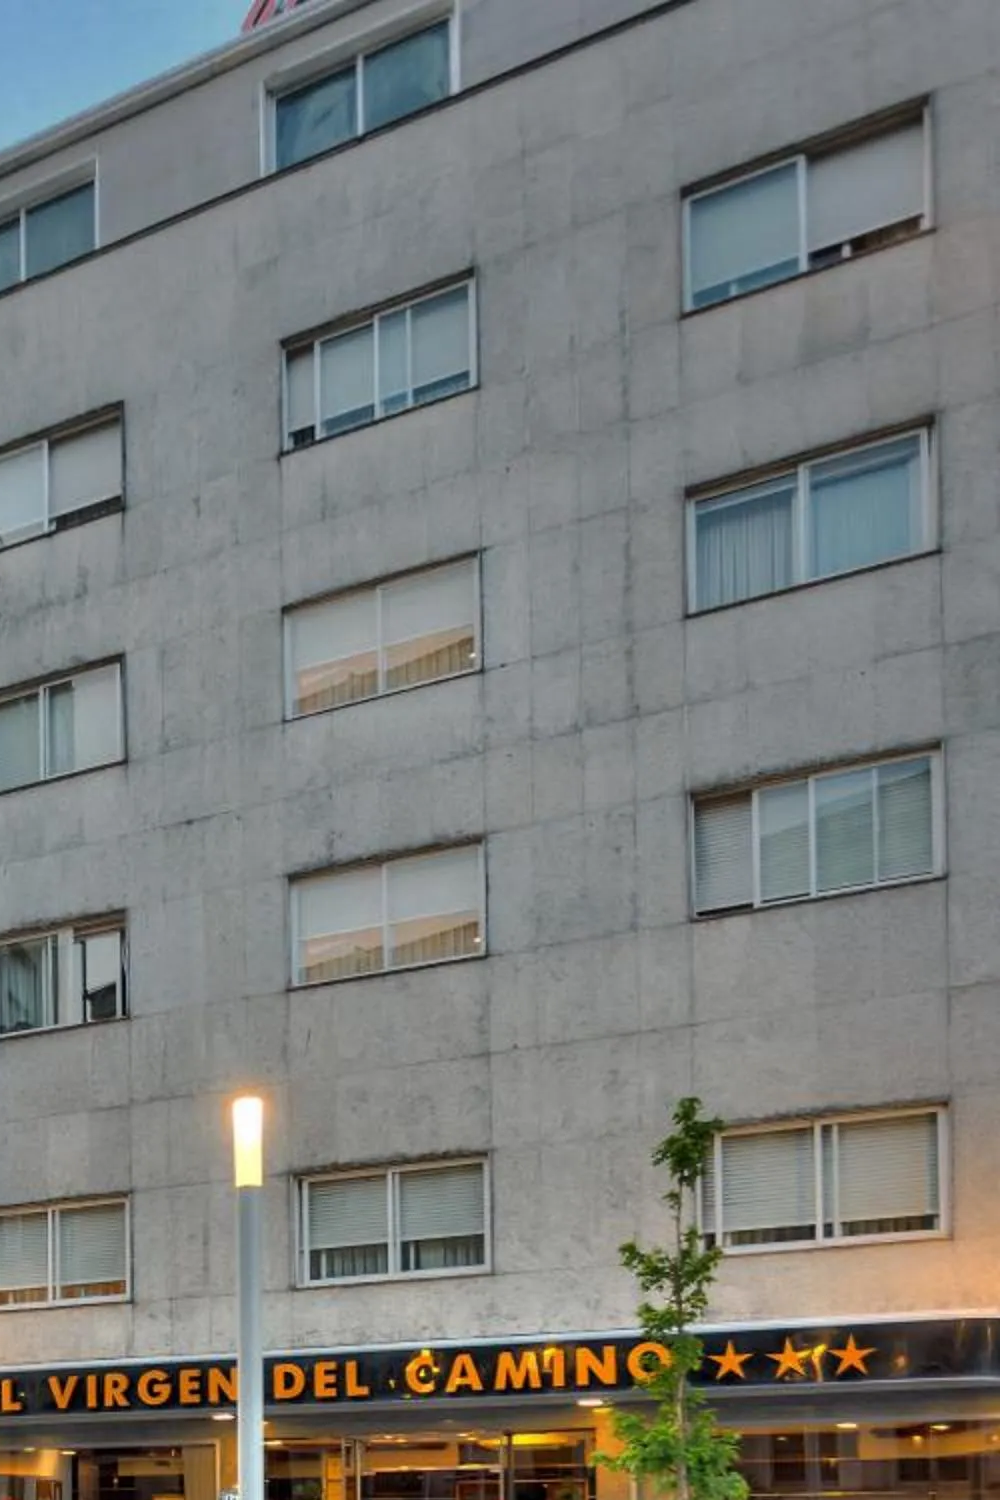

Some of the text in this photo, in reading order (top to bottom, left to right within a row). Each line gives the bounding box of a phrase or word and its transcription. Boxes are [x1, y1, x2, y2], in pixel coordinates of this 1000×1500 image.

[48, 1367, 238, 1410] VIRGEN
[273, 1360, 370, 1400] DEL
[405, 1342, 673, 1394] CAMINO
